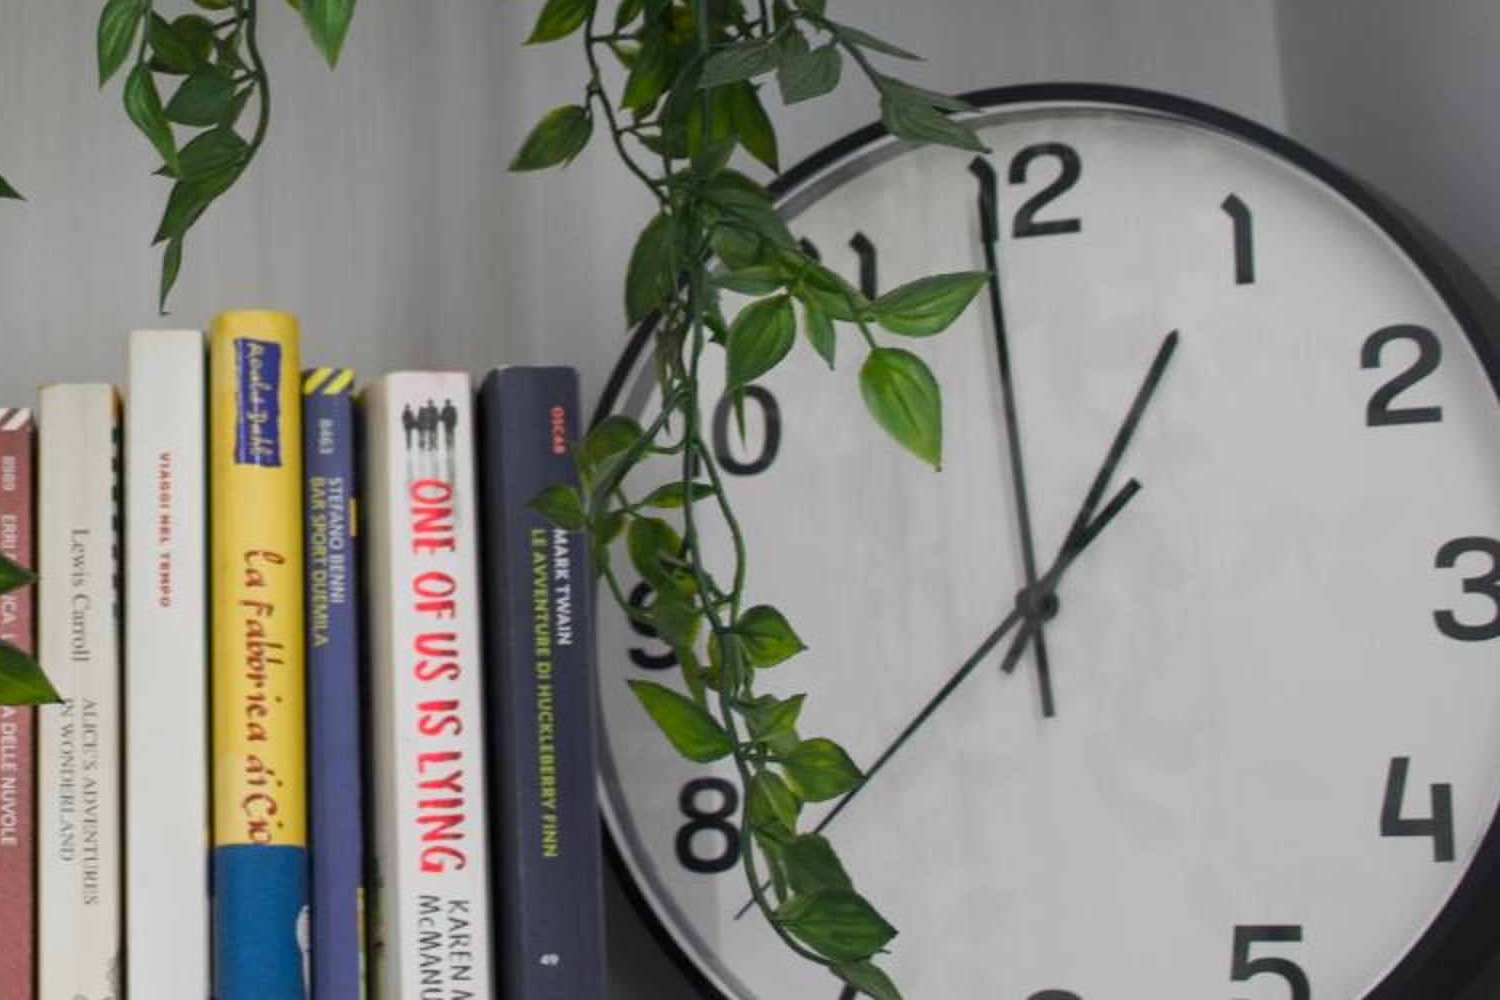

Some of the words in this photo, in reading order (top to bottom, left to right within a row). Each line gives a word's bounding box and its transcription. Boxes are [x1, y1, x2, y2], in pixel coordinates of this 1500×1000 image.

[967, 141, 1082, 240] 12
[1220, 193, 1256, 285] 1
[1360, 323, 1444, 428] 2
[245, 409, 275, 456] Dahl
[550, 407, 566, 454] OSCAR
[684, 385, 782, 476] 0
[159, 452, 171, 512] VIAGGI
[310, 477, 326, 509] BAR
[328, 477, 345, 549] STEFANO
[159, 515, 171, 545] NEL
[311, 514, 327, 564] SPORT
[410, 477, 456, 554] ONE
[531, 528, 547, 547] LE
[70, 529, 91, 588] Lewis
[158, 552, 171, 608] TEMPO
[329, 554, 345, 603] BENNI
[553, 528, 571, 579] MARK
[312, 570, 329, 647] DUEMILA
[412, 571, 457, 618] OF
[531, 552, 551, 656] AVVENTURE
[555, 584, 573, 646] TWAIN
[1432, 536, 1500, 643] 3
[70, 593, 91, 662] Carroll
[413, 633, 460, 682] US
[536, 662, 551, 679] DI
[2, 723, 18, 773] DELLE
[415, 700, 464, 736] IS
[536, 683, 558, 812] HUCKLEBERRY
[58, 723, 76, 862] WONDERLAND
[246, 755, 284, 787] di
[1, 777, 18, 846] NUVOLE
[82, 776, 100, 906] ADVENTURES
[415, 751, 467, 873] LYING
[541, 815, 559, 857] FINN
[675, 777, 740, 874] 8
[1379, 756, 1456, 862] 4
[448, 899, 473, 981] KAREN
[1230, 924, 1311, 1000] 5
